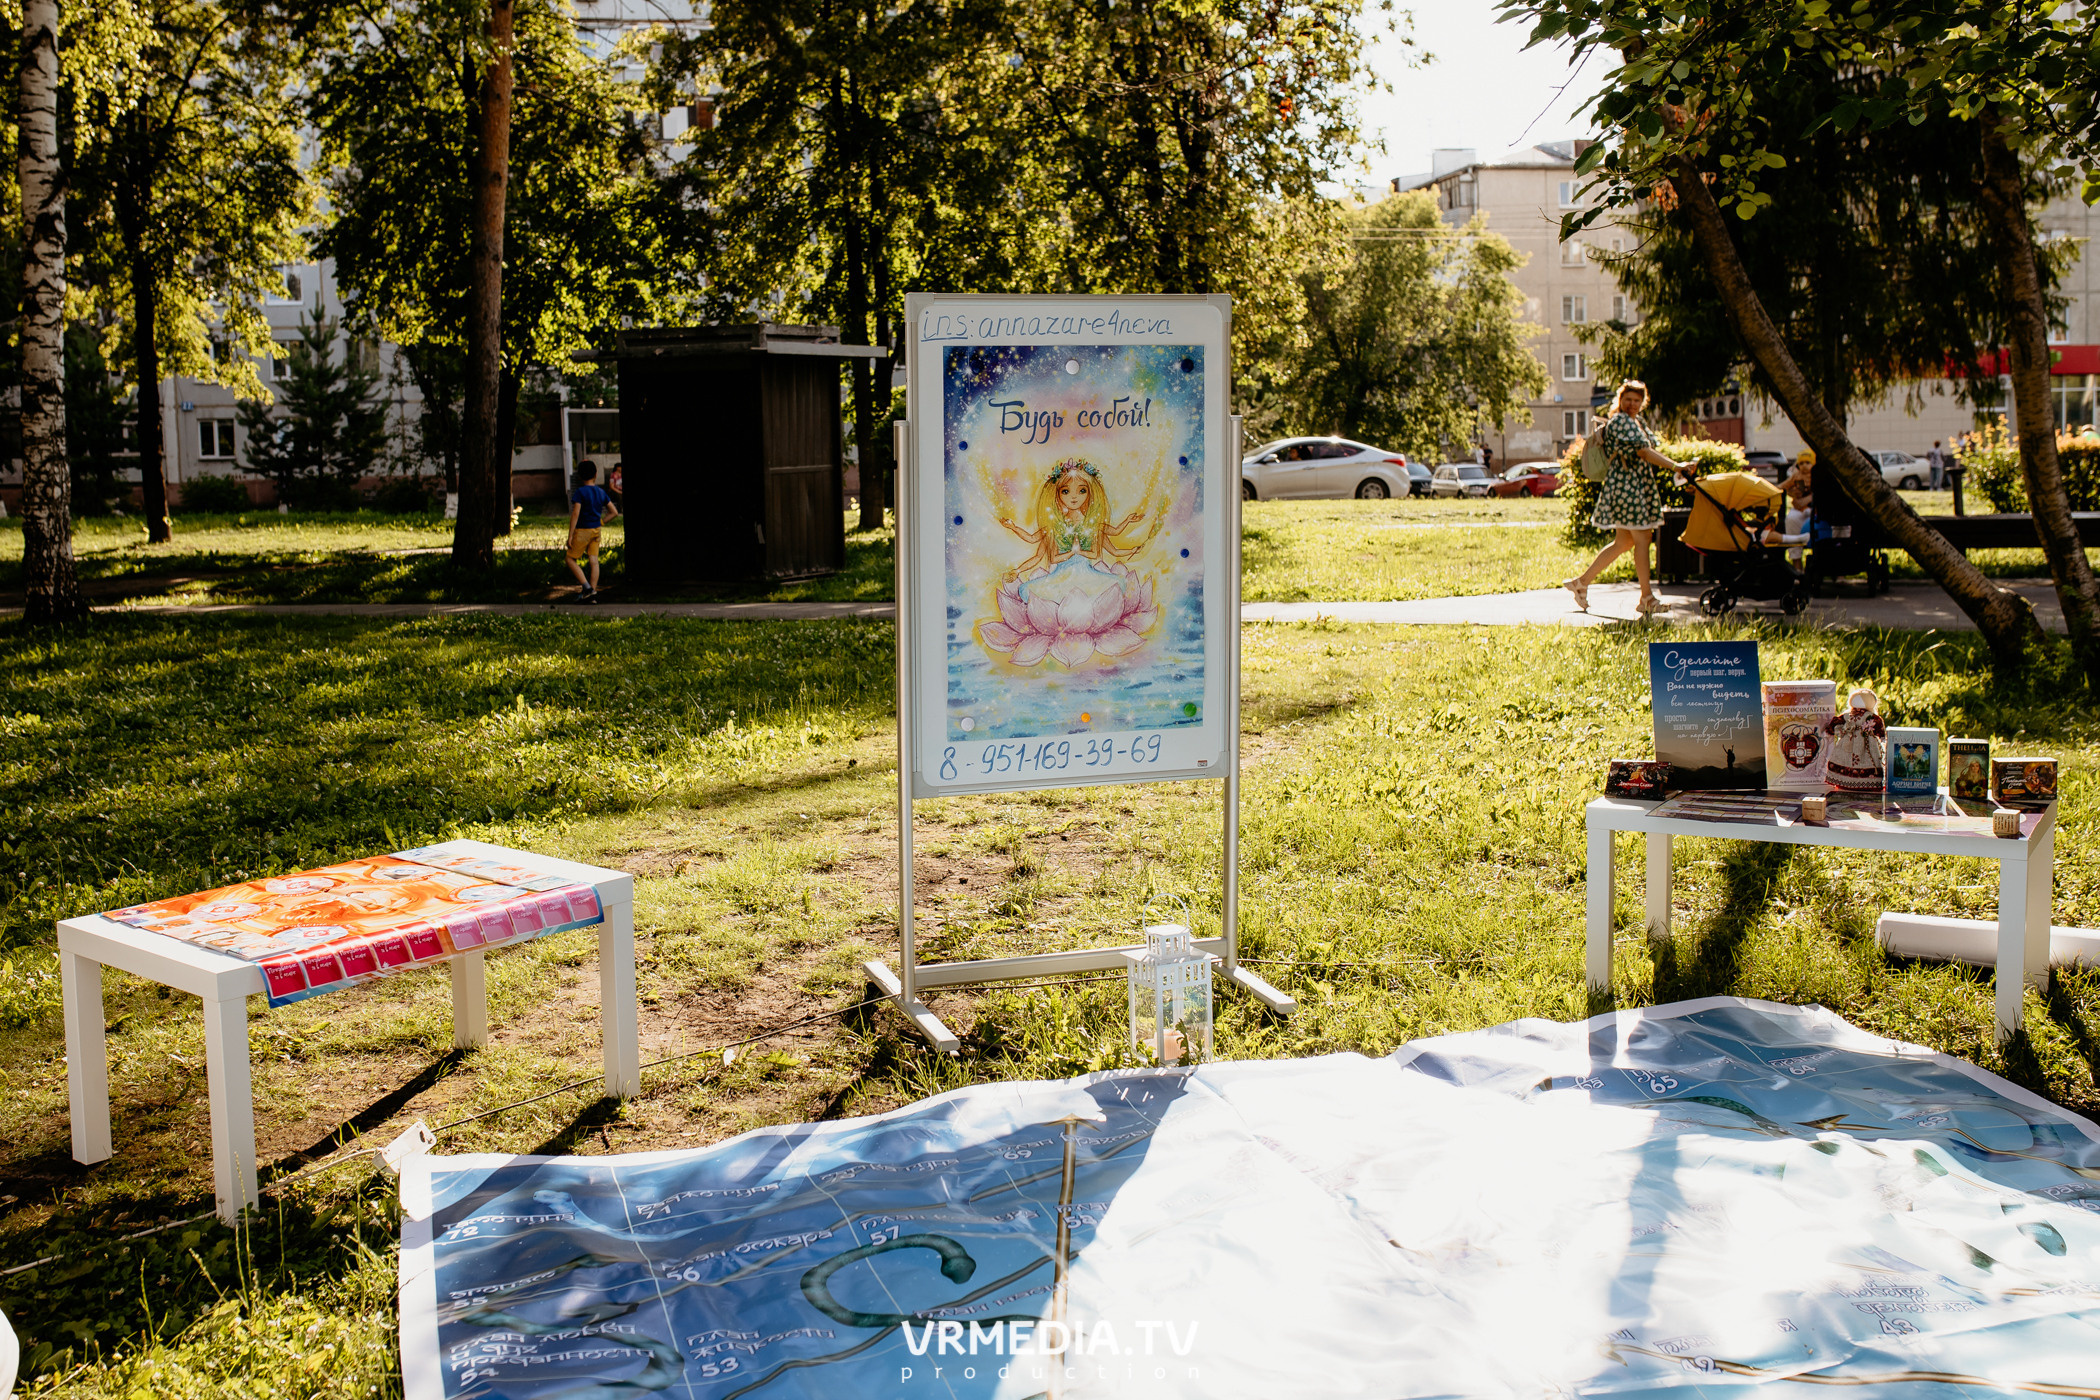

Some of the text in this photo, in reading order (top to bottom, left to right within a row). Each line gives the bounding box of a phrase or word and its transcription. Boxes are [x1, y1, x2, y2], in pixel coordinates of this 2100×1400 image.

[988, 397, 1152, 444] Будь собой!
[1664, 651, 1742, 681] Сделайте
[1667, 682, 1684, 691] Вам
[1697, 683, 1724, 691] нужно
[1713, 690, 1750, 700] видеть
[1772, 706, 1831, 714] ПСИХОСОМАТИКА
[1664, 714, 1687, 723] просто
[1789, 1065, 1817, 1075] 64
[1650, 1075, 1678, 1094] 65
[1003, 1149, 1032, 1160] 69
[446, 1226, 479, 1240] 72
[870, 1225, 900, 1246] 57
[666, 1266, 701, 1282] 56
[453, 1297, 488, 1309] 55
[1879, 1318, 1920, 1337] 43
[701, 1357, 740, 1377] 53
[1680, 1355, 1723, 1375] 42
[460, 1367, 499, 1387] 54
